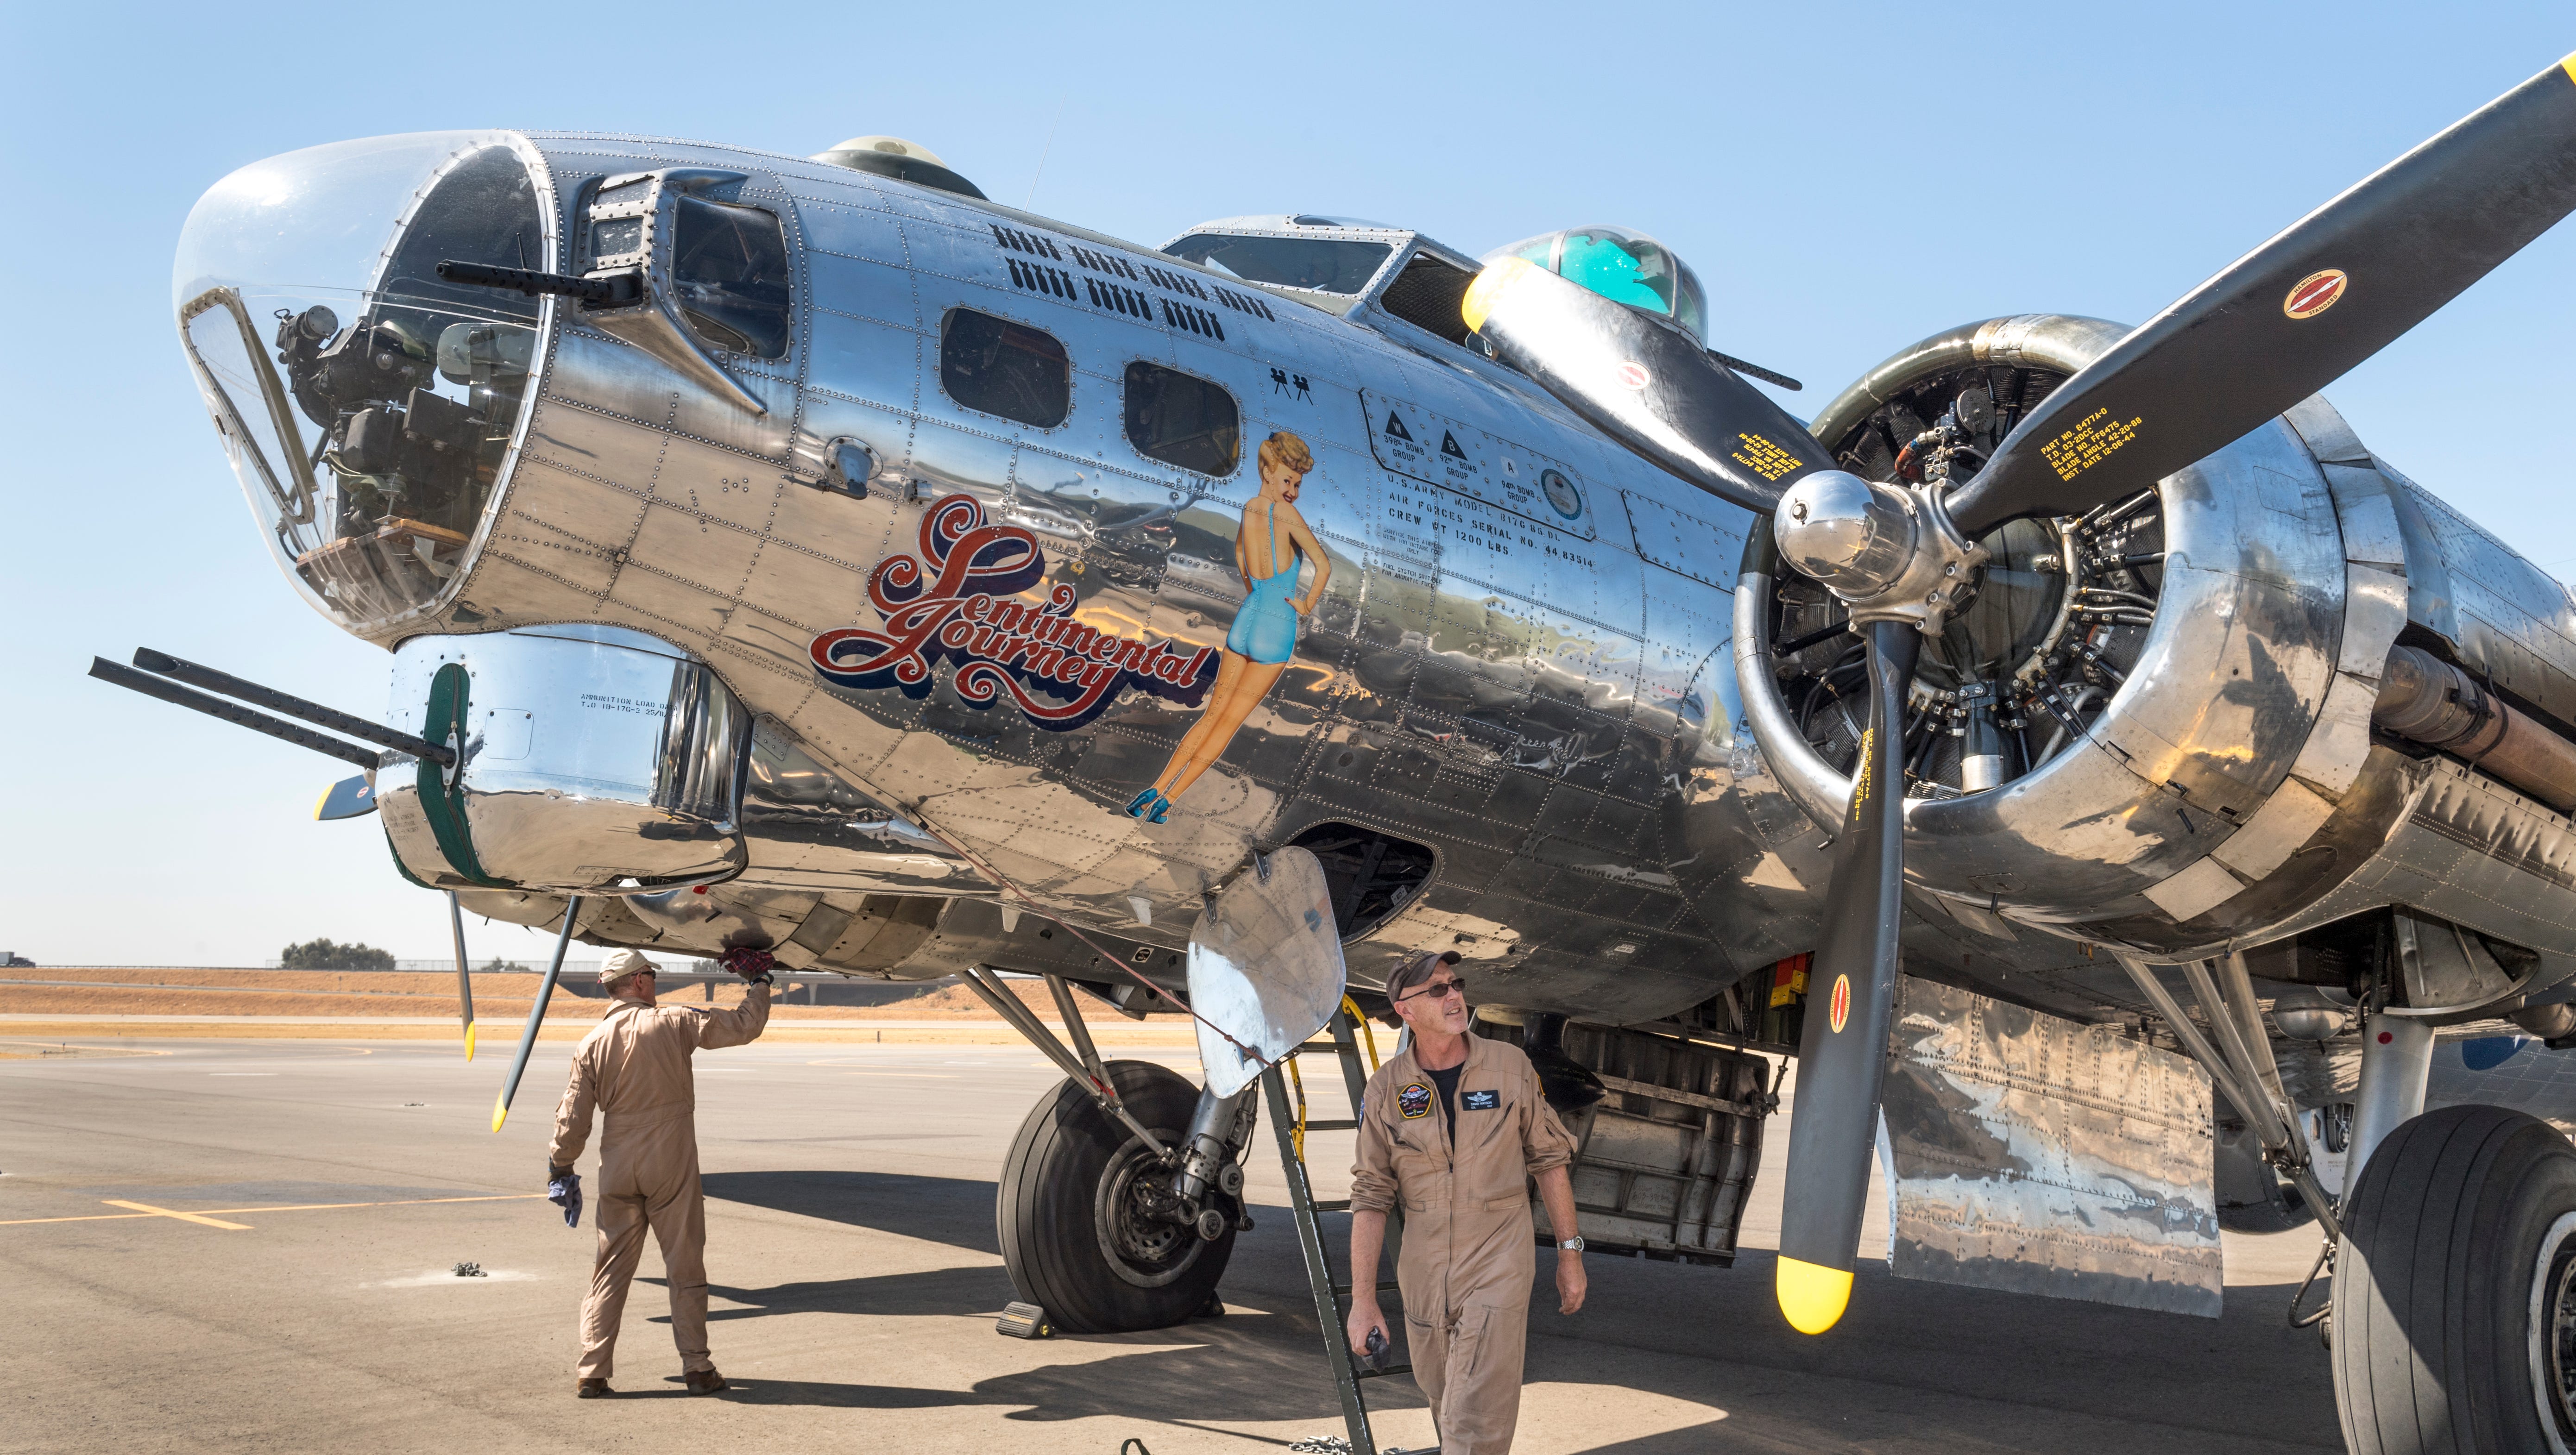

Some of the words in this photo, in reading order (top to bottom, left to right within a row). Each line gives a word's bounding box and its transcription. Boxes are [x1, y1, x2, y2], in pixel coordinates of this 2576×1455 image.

[2294, 273, 2322, 293] HAMILTON
[2309, 295, 2337, 315] STANDARD
[1393, 422, 1401, 434] W
[2041, 439, 2060, 454] PART
[2061, 431, 2075, 441] NO.
[2076, 408, 2108, 432] 6477A-0
[1405, 442, 1424, 455] BOMB
[1448, 440, 1455, 452] B
[2046, 452, 2062, 461] T.D.
[2062, 427, 2094, 451] 03-2DCC
[2052, 449, 2076, 469] BLADE
[2078, 442, 2091, 453] NO.
[2091, 420, 2120, 442] FF6475
[2057, 456, 2081, 475] BLADE
[2083, 440, 2106, 459] ANGLE
[2108, 417, 2142, 441] 42-20-88
[1392, 449, 1415, 463] GROUP
[1732, 452, 1754, 467] 6477A-0
[1761, 447, 1779, 459] ANGLE
[1774, 448, 1789, 458] DATE
[2062, 468, 2082, 482] INST.
[2082, 453, 2102, 469] DATE
[2103, 432, 2135, 456] 12-06-44
[1459, 461, 1477, 474] BOMB
[1508, 462, 1514, 473] A
[1771, 461, 1790, 473] BLADE
[1778, 458, 1796, 470] BLADE
[1789, 457, 1803, 467] INST.
[1447, 467, 1468, 481] GROUP
[1762, 471, 1777, 481] PART
[1773, 469, 1783, 477] T.D.
[1501, 480, 1515, 489] 94th
[1517, 485, 1535, 498] BOMB
[1507, 491, 1527, 504] GROUP
[1455, 497, 1492, 516] MODEL
[1501, 513, 1525, 528] B17G
[1548, 531, 1560, 541] DL
[1384, 528, 1404, 538] SERVICE
[1389, 508, 1421, 525] CREW
[1456, 530, 1481, 546] 1200
[1488, 540, 1513, 556] LBS.
[1390, 492, 1408, 505] AIR
[1418, 501, 1462, 523] FORCES
[1472, 520, 1512, 540] SERIAL
[1520, 536, 1537, 549] NO.
[1563, 551, 1593, 567] 83514
[1410, 542, 1429, 552] OCTANE
[1383, 563, 1395, 571] FUEL
[1398, 567, 1416, 577] SYSTEM
[1394, 573, 1418, 584] AROMATIC
[865, 492, 1218, 688] Sentimental
[581, 694, 631, 705] AMMUNITION
